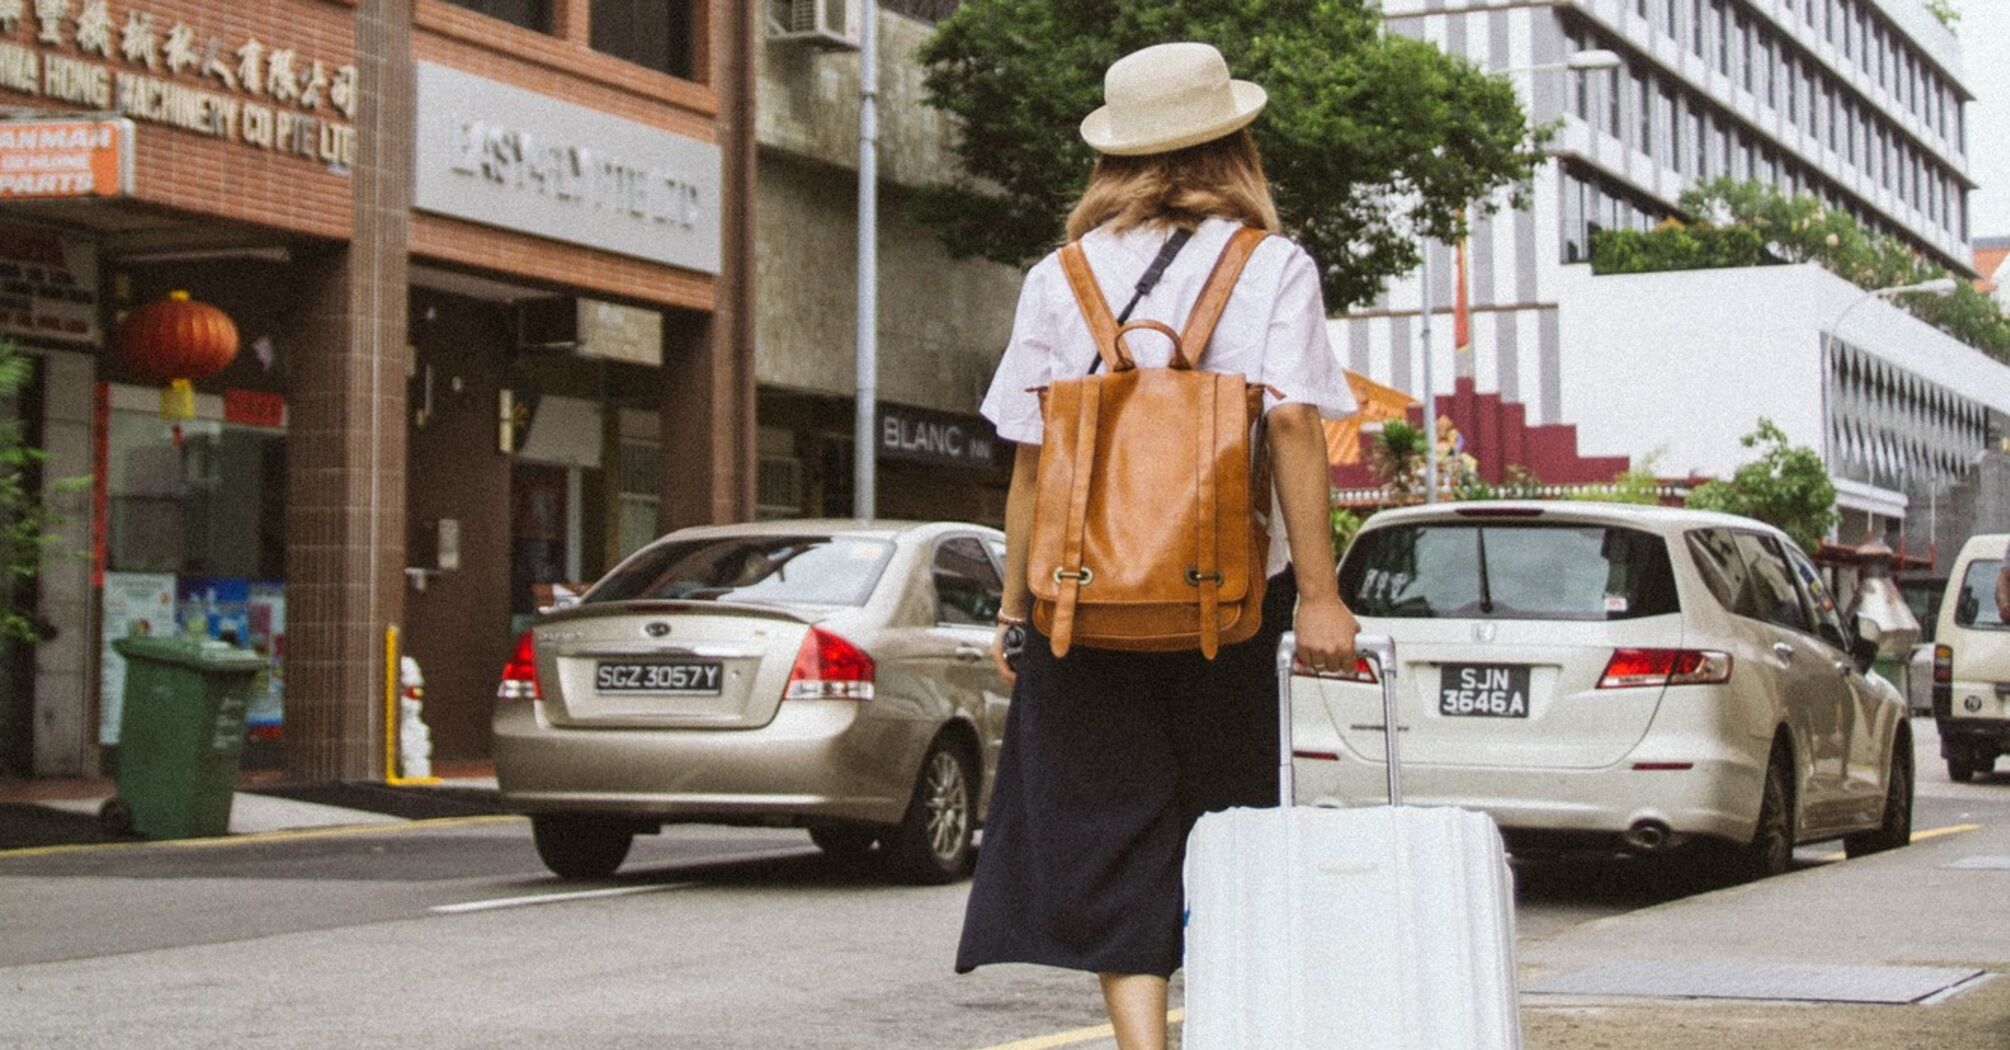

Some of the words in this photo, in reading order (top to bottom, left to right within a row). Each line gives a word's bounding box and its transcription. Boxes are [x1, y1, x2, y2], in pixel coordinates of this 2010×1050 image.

[44, 52, 111, 110] HONG
[115, 72, 239, 142] MACHINERY
[243, 102, 273, 148] CO
[276, 110, 316, 159] PTE
[883, 415, 961, 456] BLANC
[598, 666, 640, 688] SGZ
[1461, 668, 1509, 690] SJN
[1443, 689, 1525, 715] 3646A
